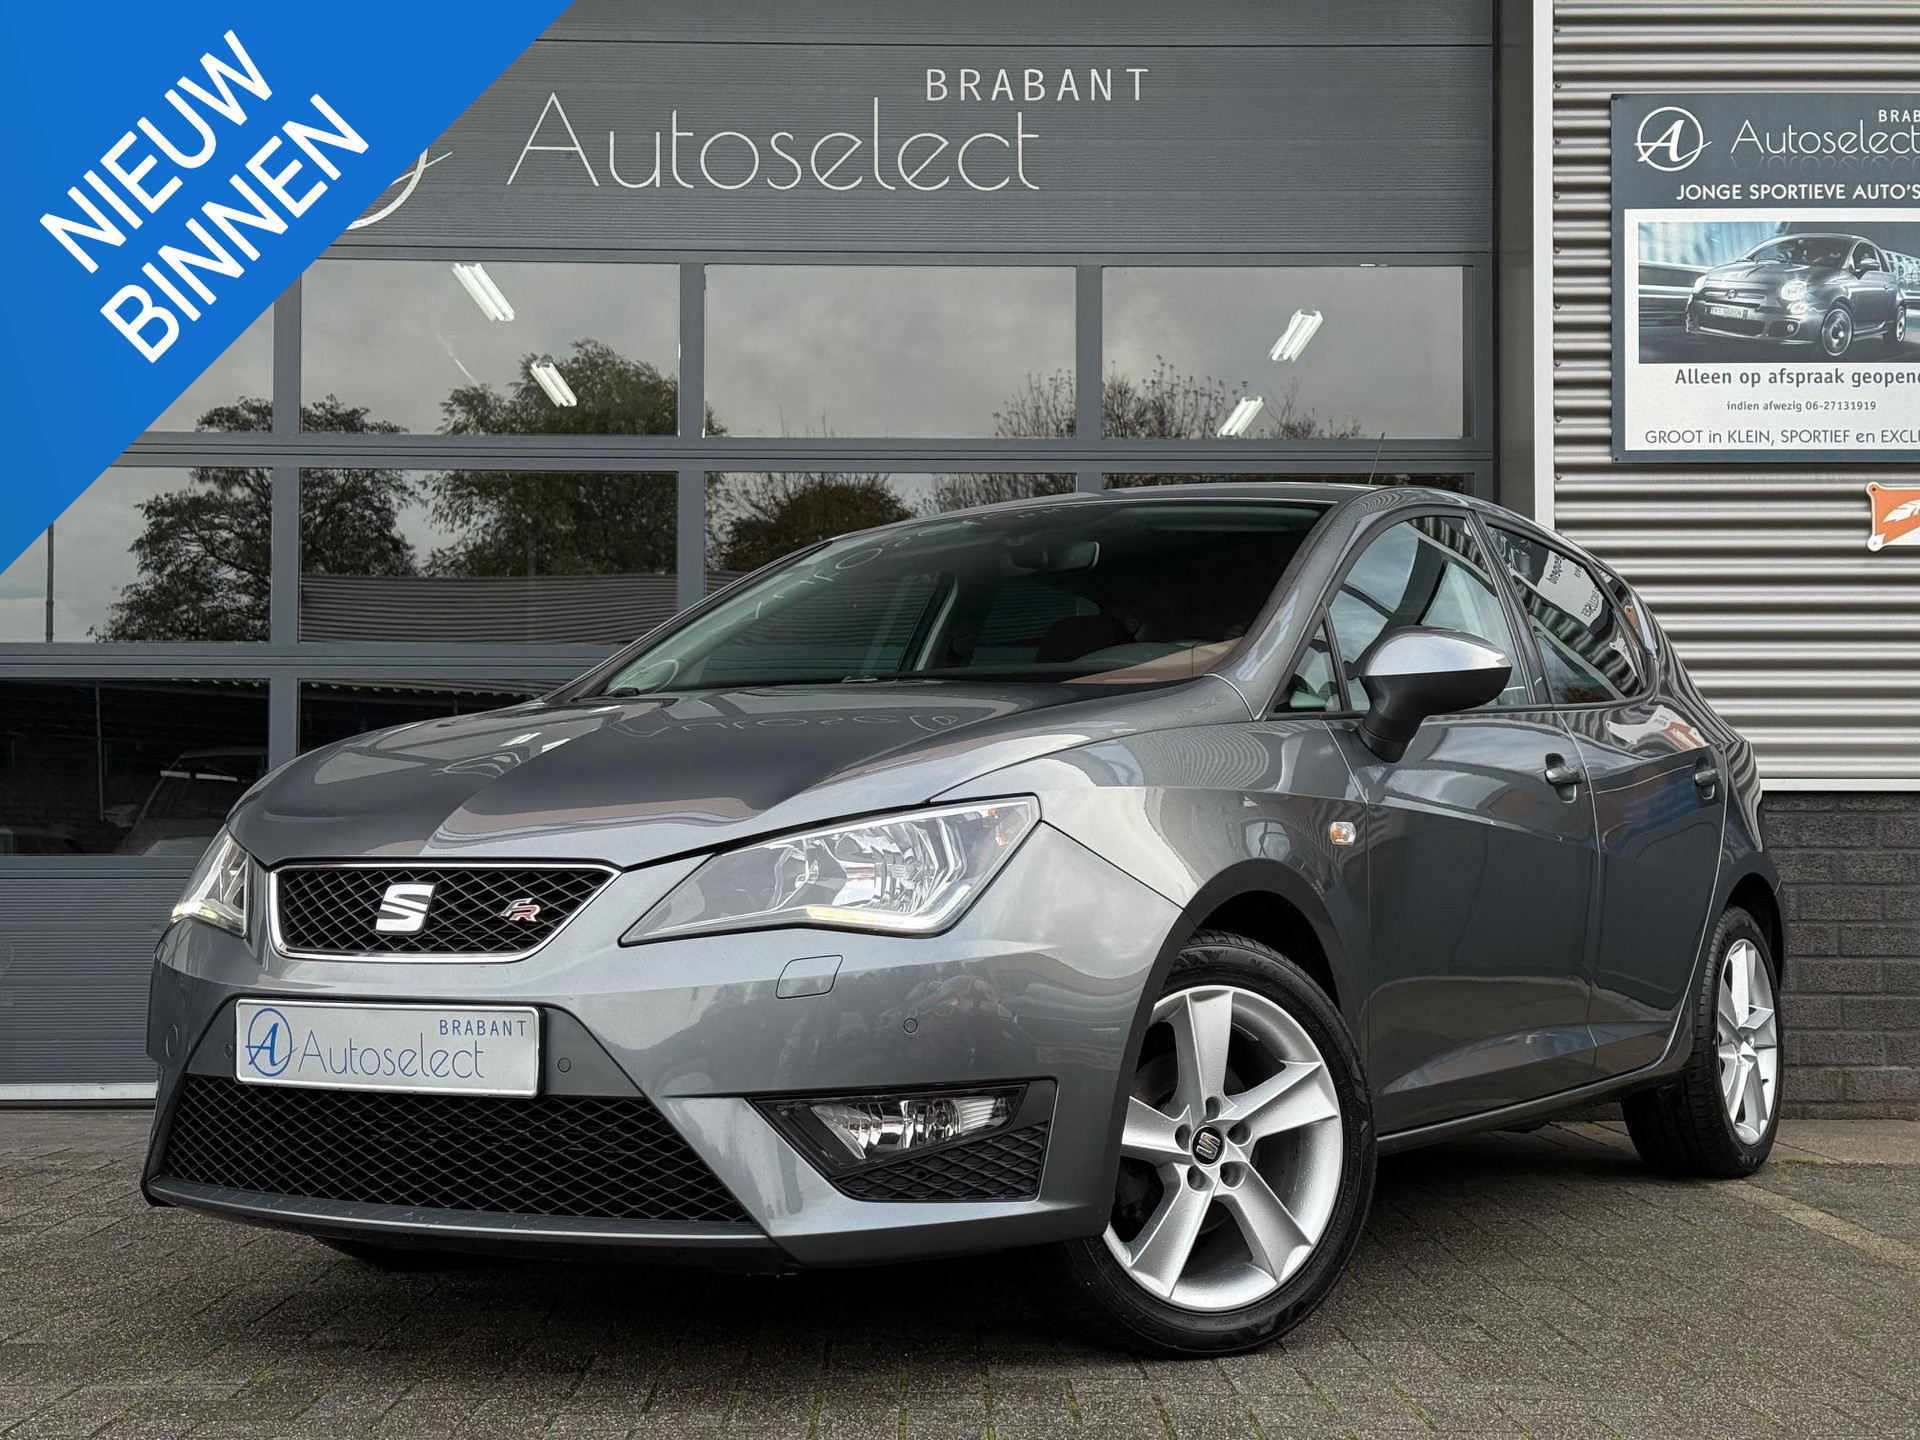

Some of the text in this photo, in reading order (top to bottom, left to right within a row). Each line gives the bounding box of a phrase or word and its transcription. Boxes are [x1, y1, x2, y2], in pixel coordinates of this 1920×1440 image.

[926, 68, 1149, 102] BRABANT
[506, 92, 1040, 191] Autoselect
[1730, 119, 1920, 154] Autoselect
[1676, 183, 1920, 201] JONGE SPORTIEVE AUTO'S
[1675, 367, 1920, 388] Alleen op afspraak geopen
[1726, 400, 1877, 413] indien afwezig 06-27131919
[1645, 429, 1920, 447] GROOT in KLEIN, SPORTIEF en EXCL
[438, 1019, 527, 1037] BRABANT
[298, 1029, 485, 1079] Autoselect
